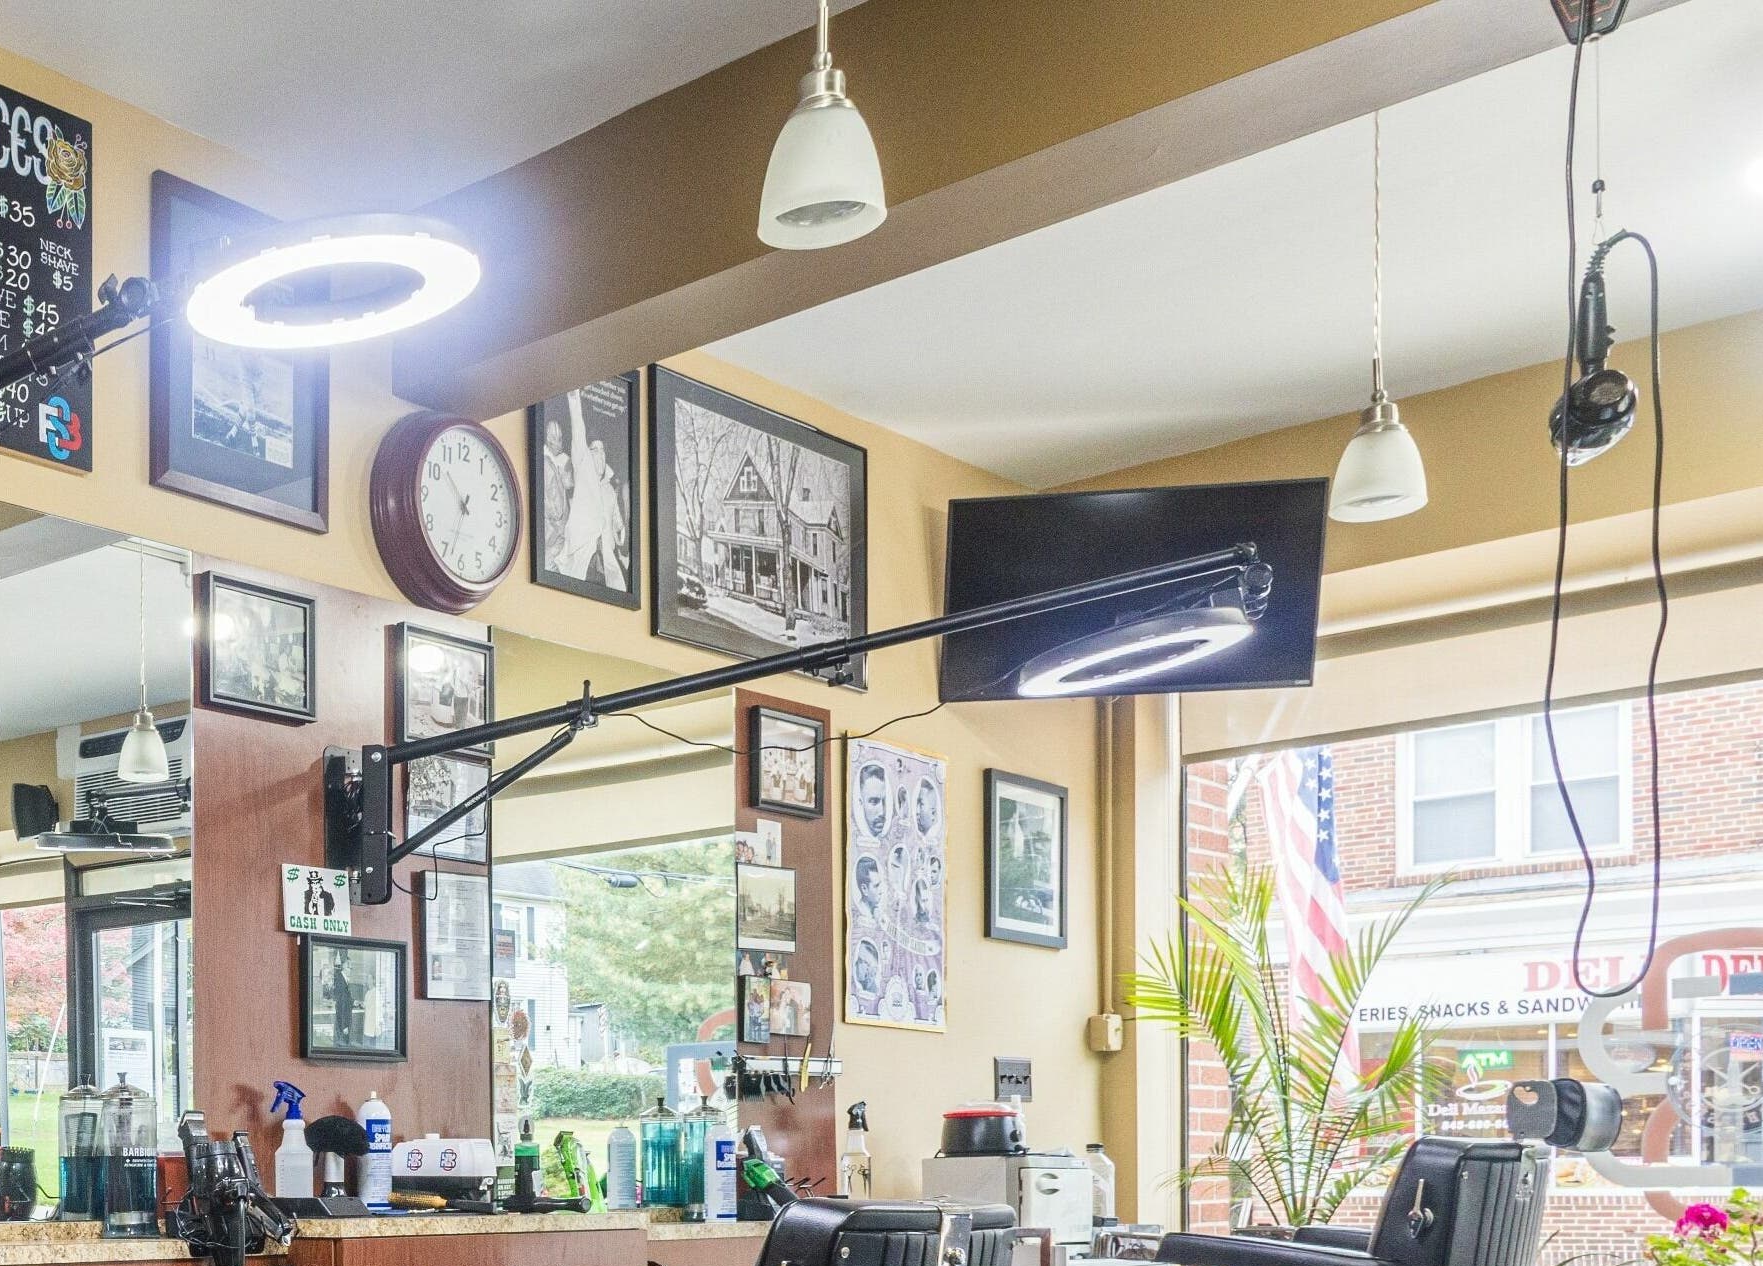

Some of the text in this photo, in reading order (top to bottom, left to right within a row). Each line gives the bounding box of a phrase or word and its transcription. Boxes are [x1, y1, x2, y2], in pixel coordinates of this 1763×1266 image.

[40, 238, 73, 260] NECK
[40, 252, 79, 277] SHAVE
[53, 270, 73, 291] $5
[23, 295, 59, 325] $45
[22, 318, 56, 337] $4
[443, 445, 452, 464] 11
[458, 443, 470, 463] 12
[428, 461, 440, 480] 10
[479, 458, 484, 475] 1
[422, 485, 428, 502] 9
[490, 484, 498, 501] 2
[426, 513, 433, 531] 8
[495, 511, 502, 528] 3
[442, 541, 449, 557] 7
[489, 536, 496, 552] 4
[457, 554, 464, 571] 6
[475, 552, 482, 569] 5
[287, 867, 347, 888] $ $
[290, 915, 349, 933] CASH ONLY
[1523, 955, 1646, 992] DEL
[1419, 1001, 1490, 1019] SNACKS
[1497, 1000, 1508, 1014] &
[1462, 1050, 1509, 1072] ATM
[1428, 1103, 1458, 1116] Deli
